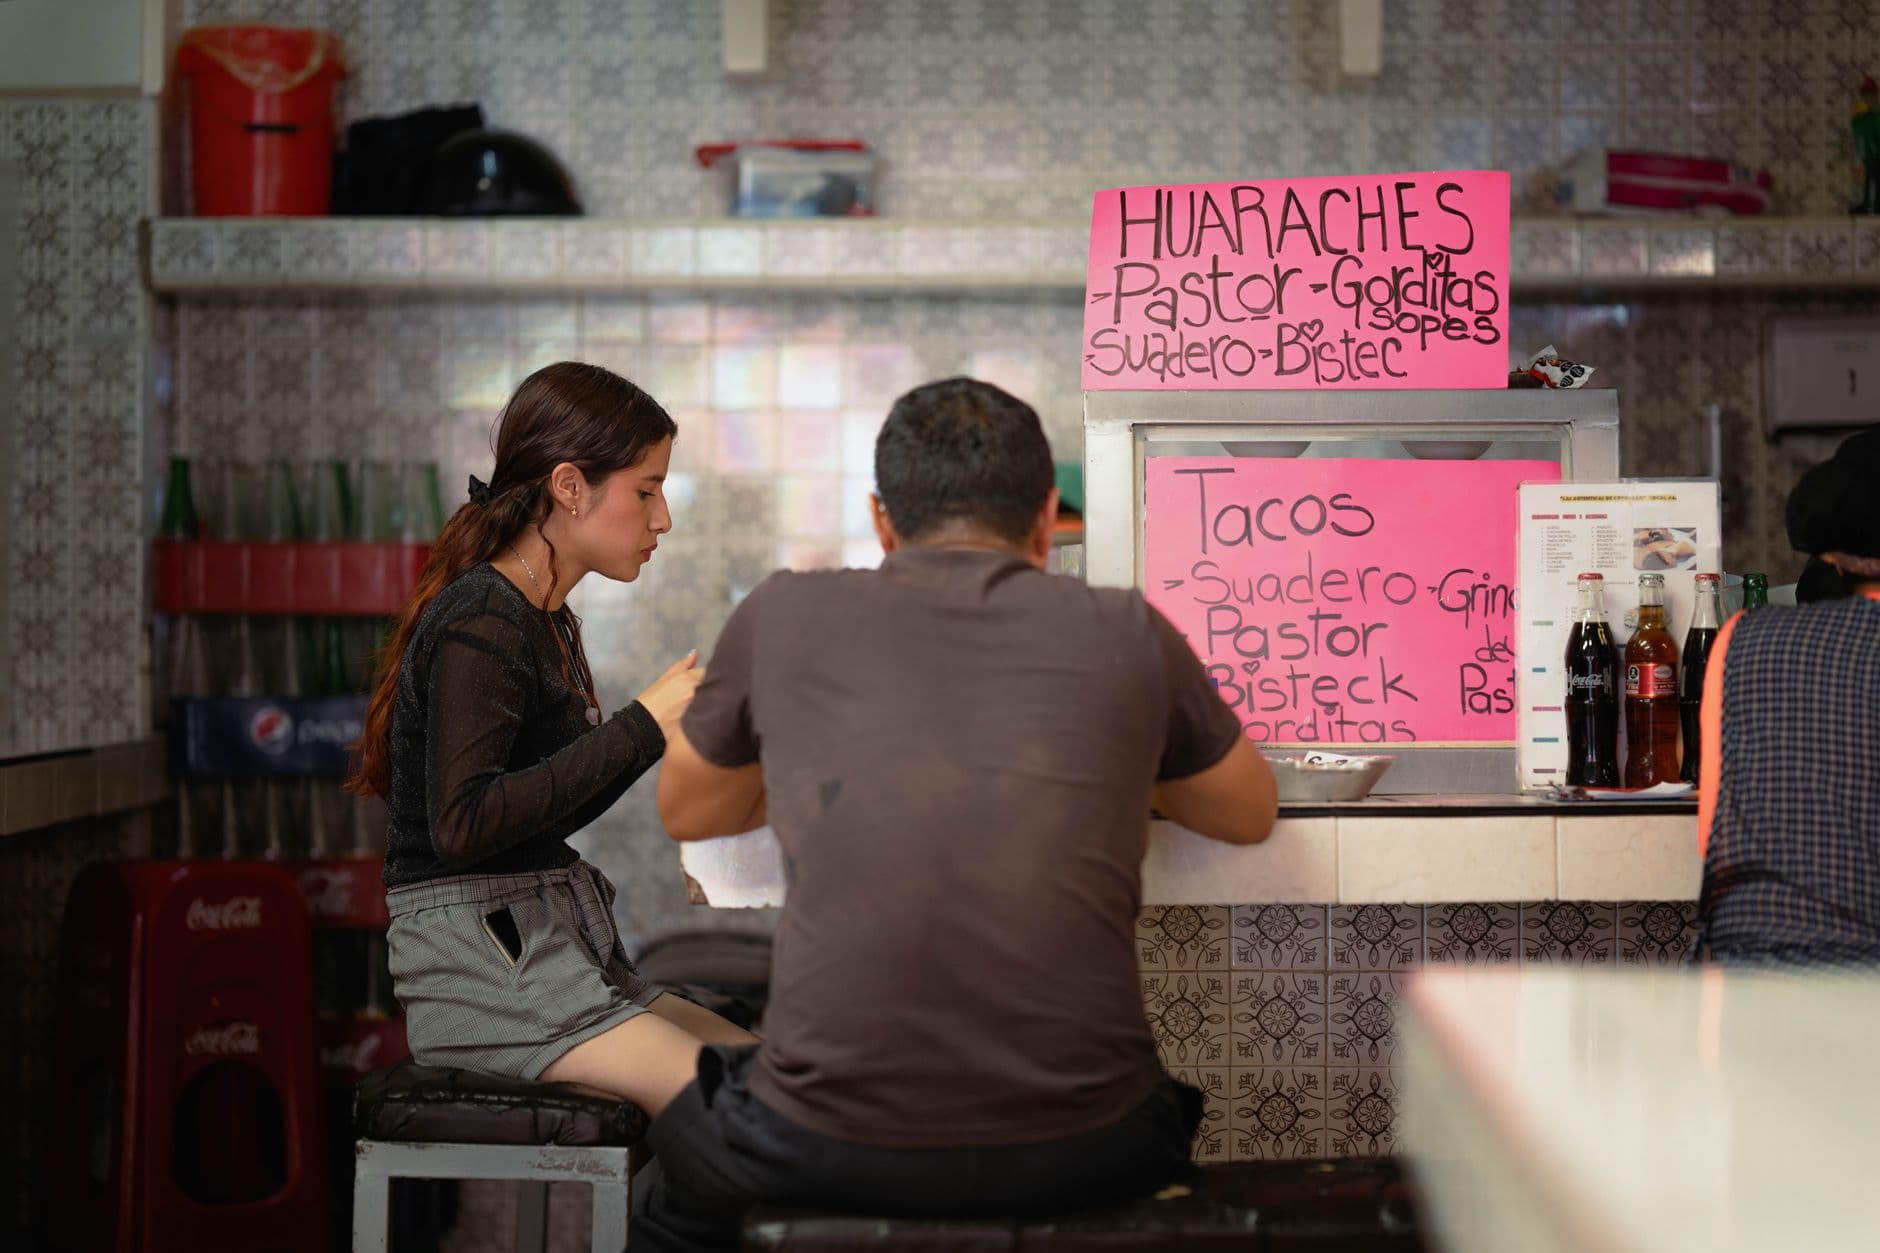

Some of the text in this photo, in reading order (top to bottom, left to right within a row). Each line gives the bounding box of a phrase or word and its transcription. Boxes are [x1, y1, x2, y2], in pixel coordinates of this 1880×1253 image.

[1120, 182, 1474, 259] HUARACHES
[1368, 307, 1501, 351] sopes
[1174, 468, 1375, 554] Tacos
[1206, 604, 1389, 661] Pastor
[1206, 656, 1419, 714] Bisteck
